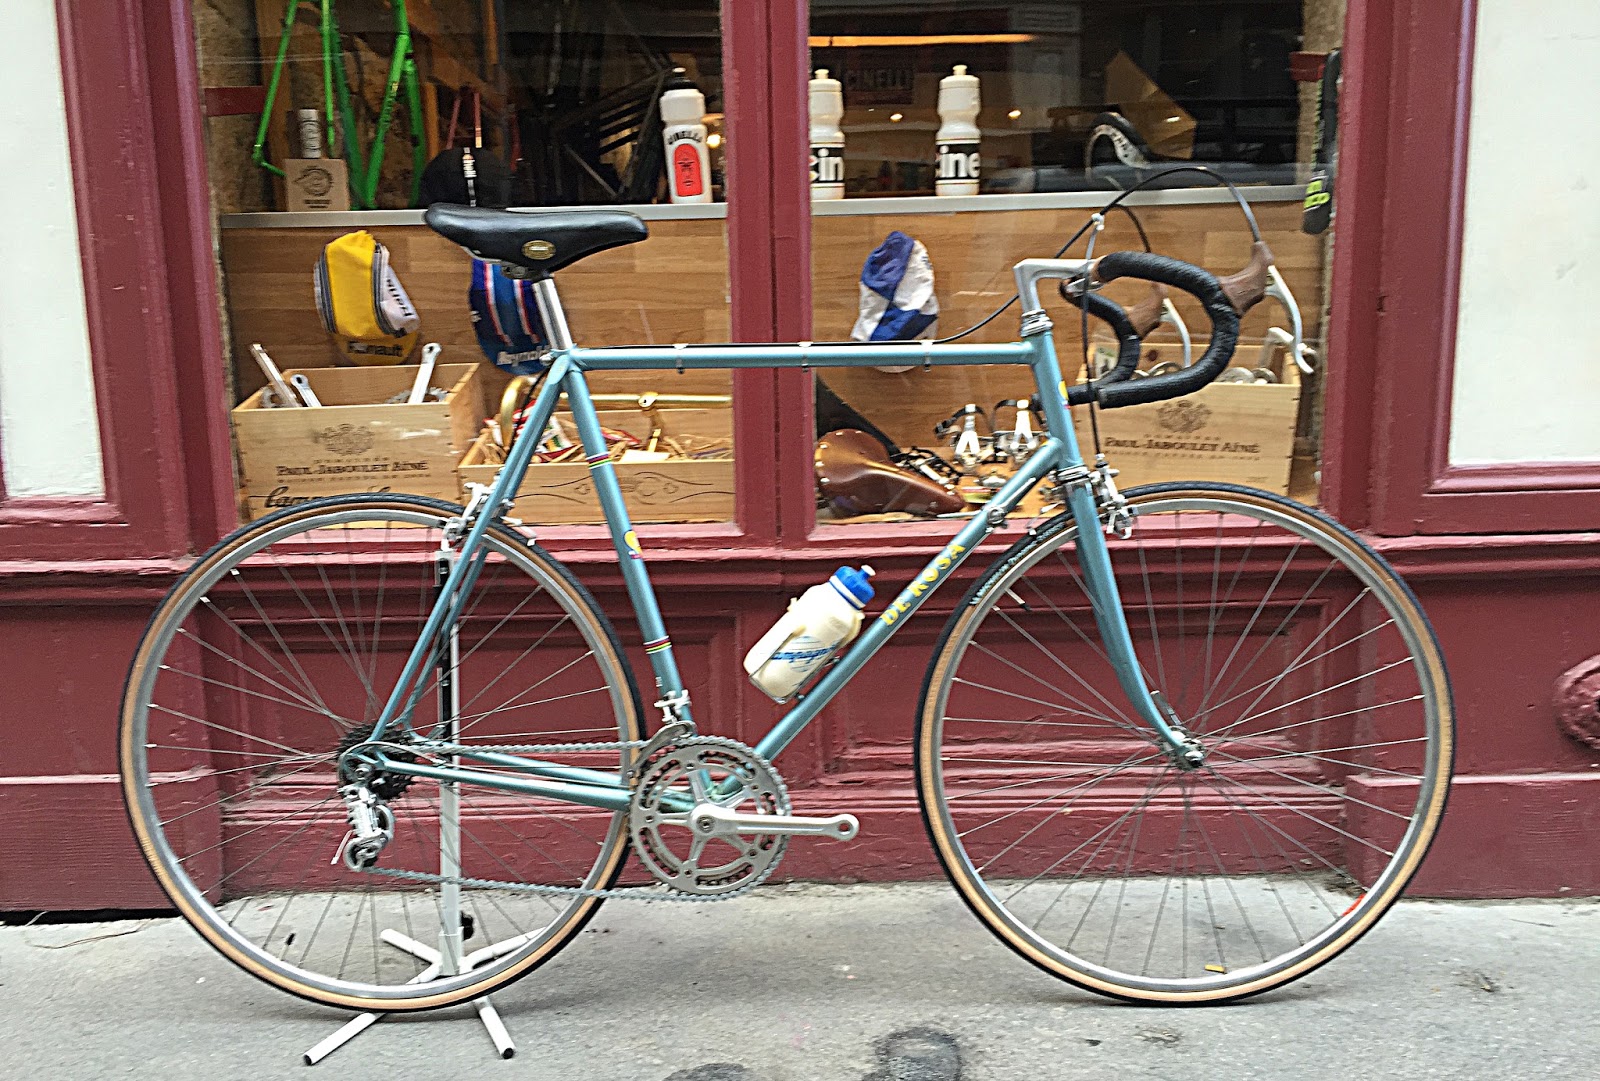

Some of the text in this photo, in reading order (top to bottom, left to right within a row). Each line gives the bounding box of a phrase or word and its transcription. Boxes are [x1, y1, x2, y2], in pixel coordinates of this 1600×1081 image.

[937, 144, 981, 178] ine
[879, 595, 912, 626] DE
[906, 542, 967, 598] ROSA
